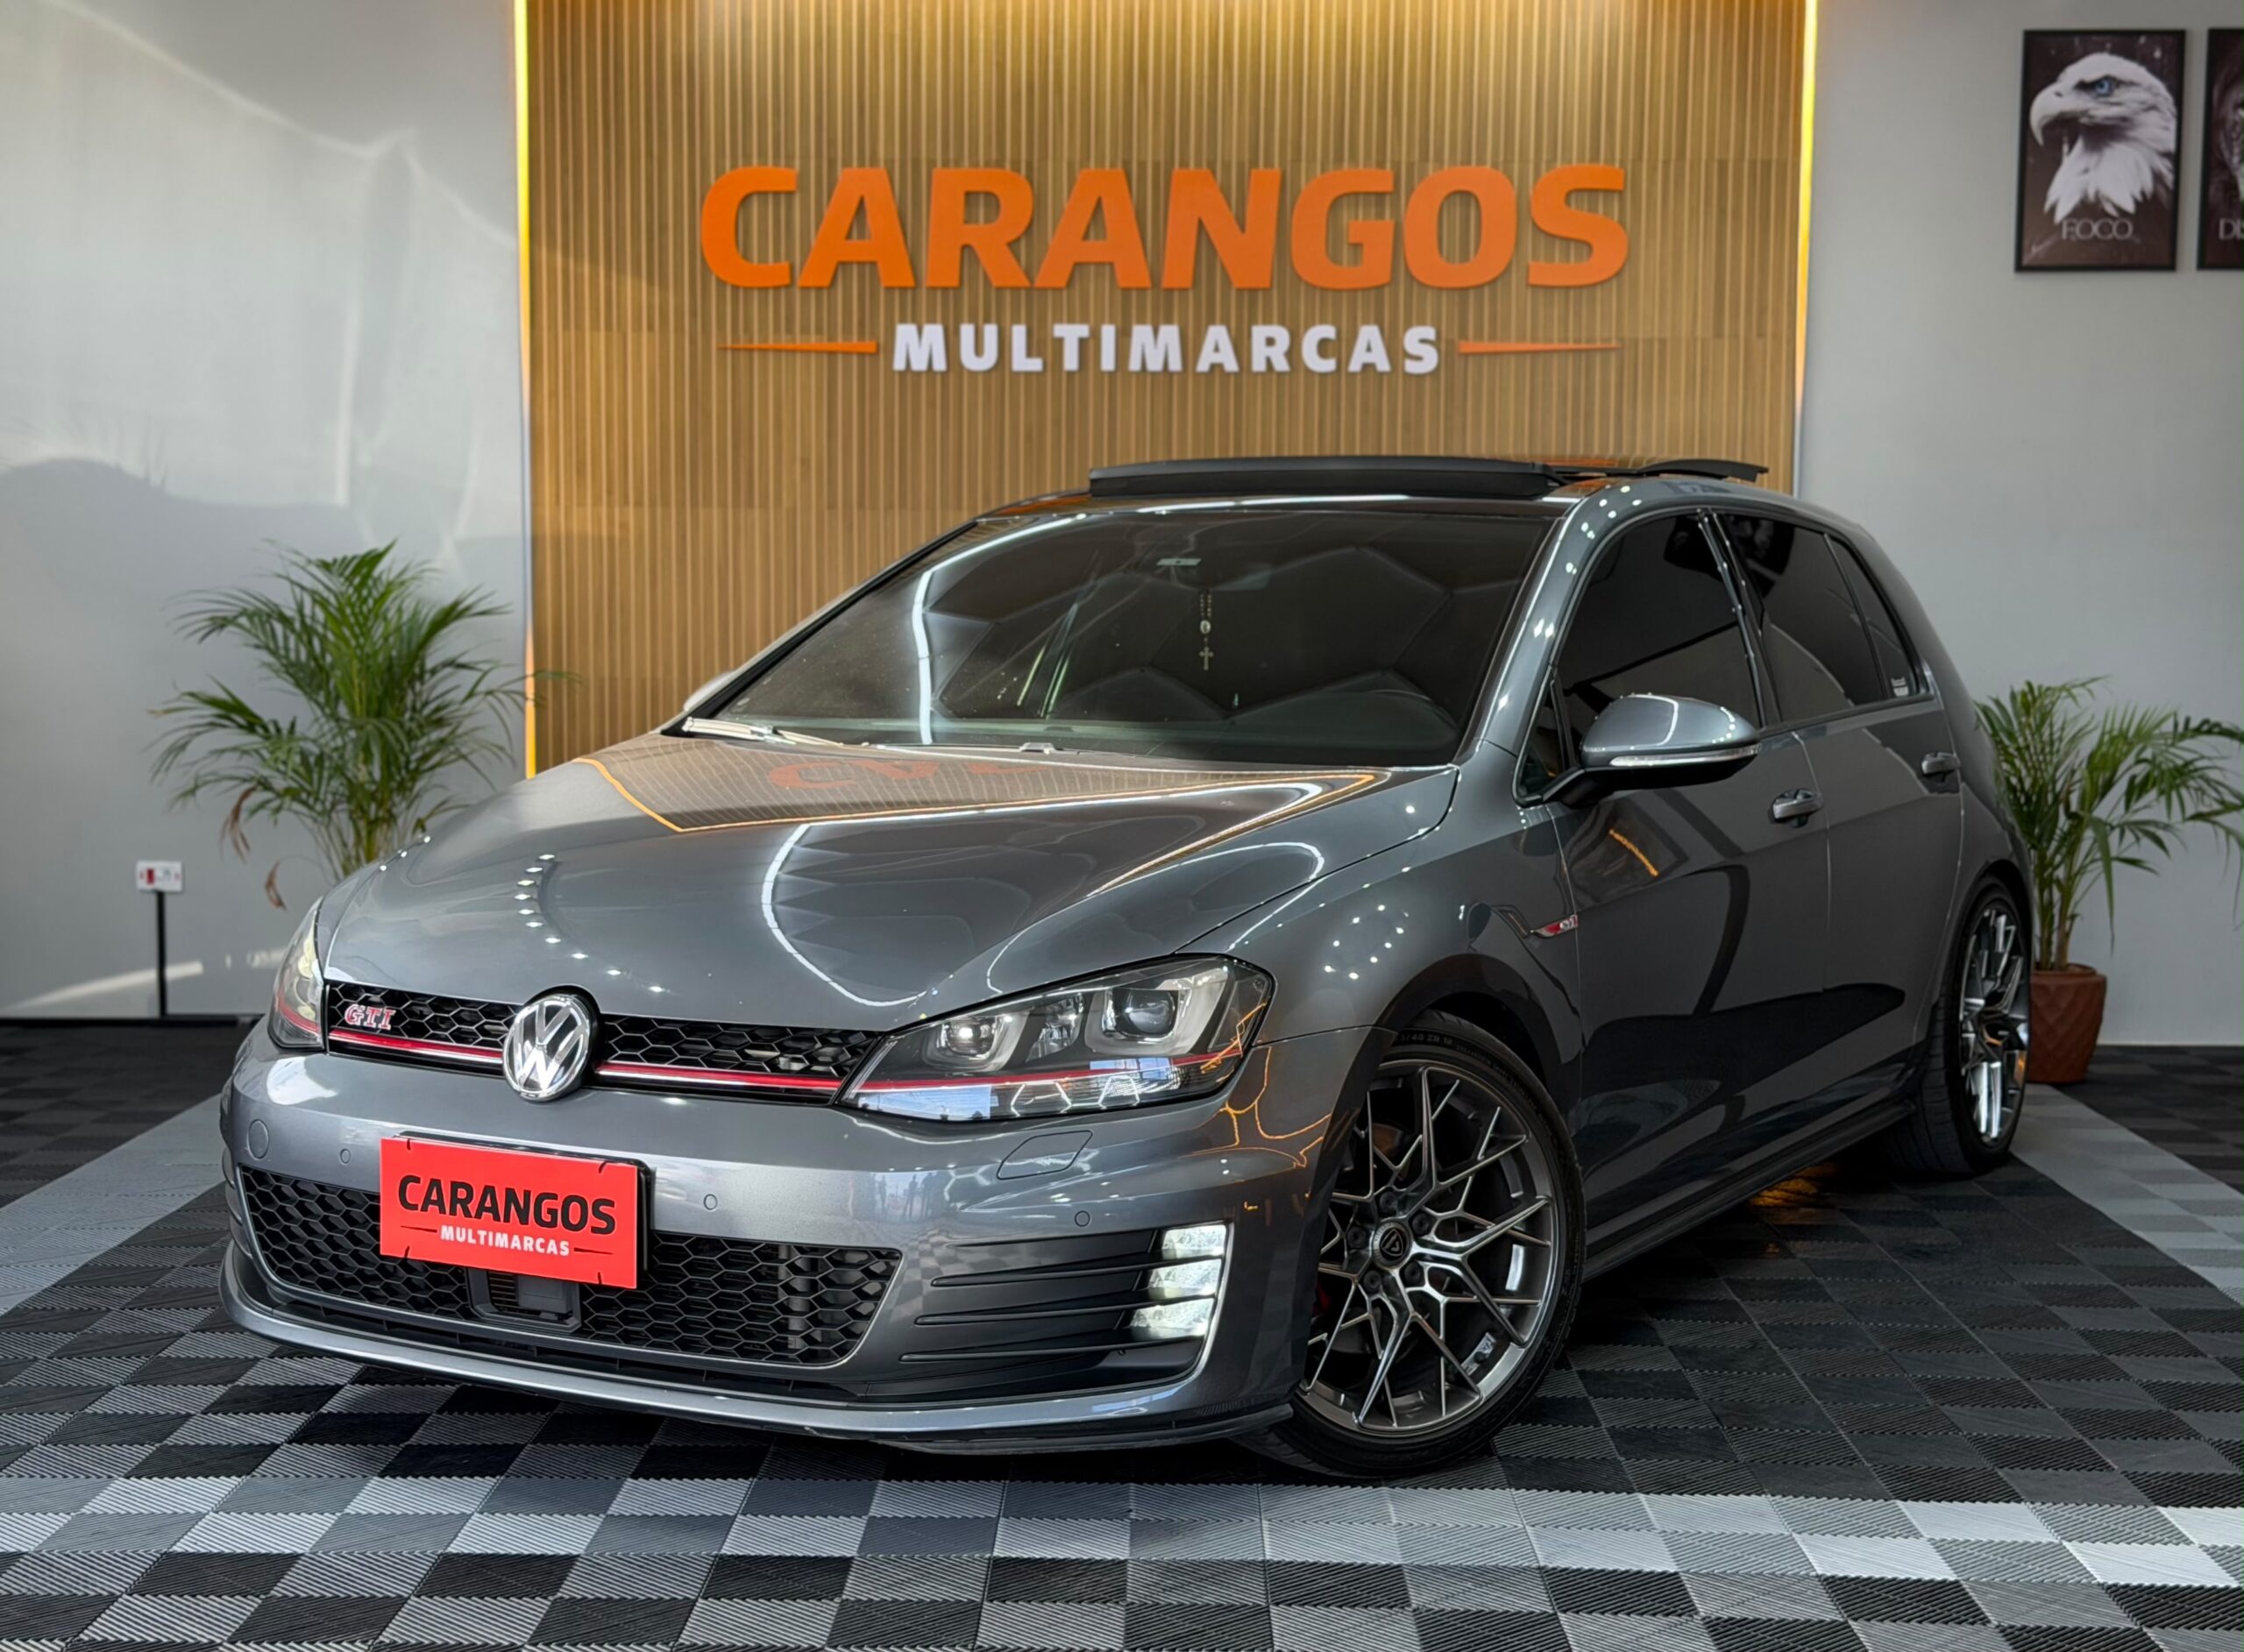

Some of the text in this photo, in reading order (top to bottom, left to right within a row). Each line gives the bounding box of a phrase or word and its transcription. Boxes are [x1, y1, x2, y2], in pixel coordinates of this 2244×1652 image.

[700, 163, 1630, 290] CARANGOS
[2061, 217, 2134, 240] FOCO
[892, 323, 1439, 374] MULTIMARCAS
[344, 1003, 396, 1031] GTI
[398, 1174, 616, 1236] CARANGOS
[440, 1225, 571, 1257] MULTIMARCAS
